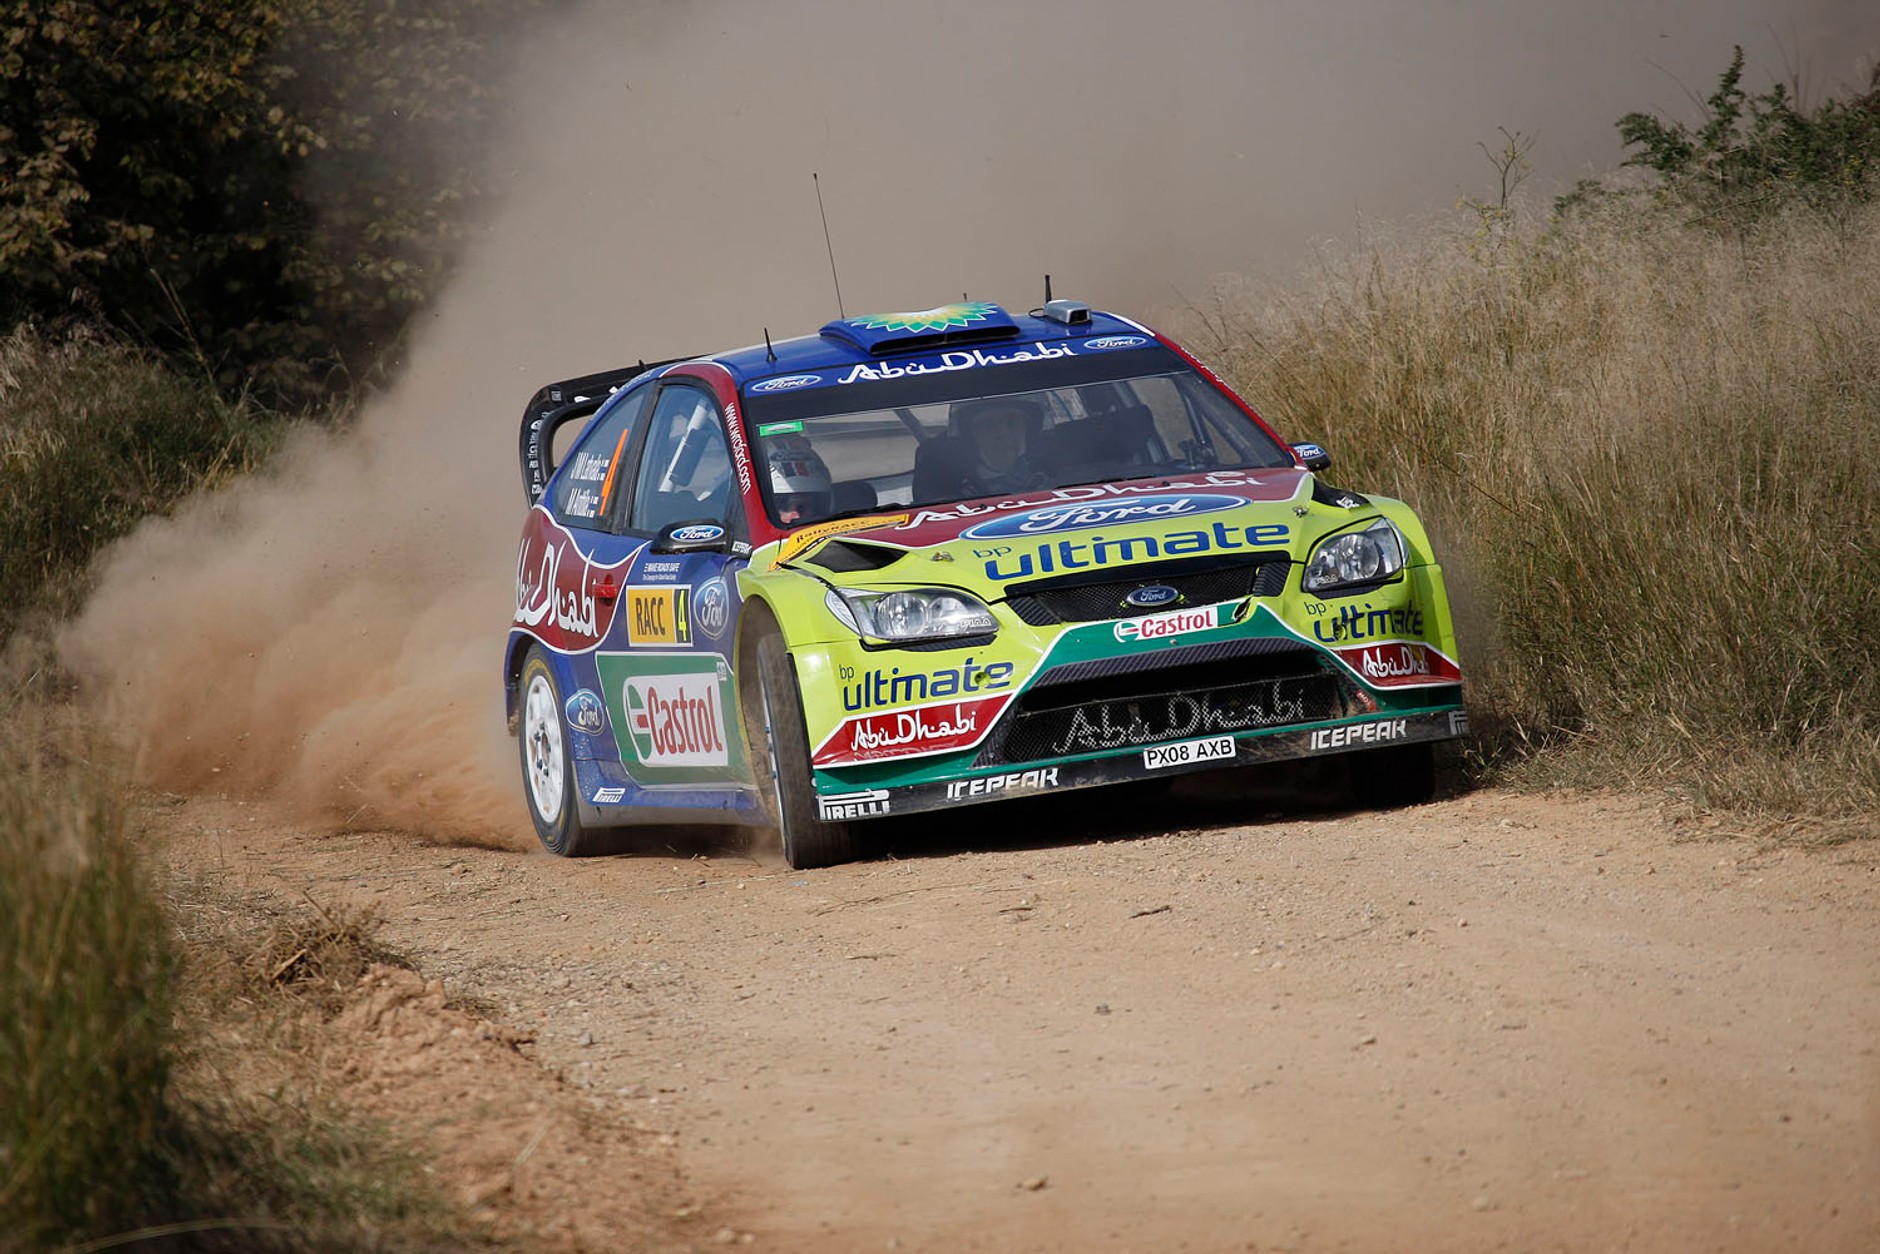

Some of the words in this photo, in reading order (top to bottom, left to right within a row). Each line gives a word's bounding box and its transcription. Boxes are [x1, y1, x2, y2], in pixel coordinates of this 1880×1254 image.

[1097, 337, 1135, 348] Ford
[764, 377, 810, 390] Ford
[1019, 498, 1195, 533] Ford
[680, 527, 714, 539] Ford
[972, 544, 1012, 559] bp
[984, 521, 1291, 581] ultimate
[702, 586, 725, 628] Ford
[1140, 588, 1166, 601] Ford
[1304, 602, 1327, 616] bp
[635, 596, 666, 636] RACC
[678, 589, 687, 642] 4
[1141, 611, 1213, 637] Castrol
[839, 664, 854, 682] bp
[843, 657, 1014, 711] ultimate
[577, 696, 600, 726] Ford
[647, 685, 723, 756] Castrol
[1311, 720, 1407, 750] ICEPEAK
[1148, 747, 1190, 765] PX08
[1197, 739, 1232, 758] AXB
[592, 787, 626, 803] PIRELLI
[947, 768, 1059, 801] ICEPEAK
[817, 788, 890, 820] PIRELLI
